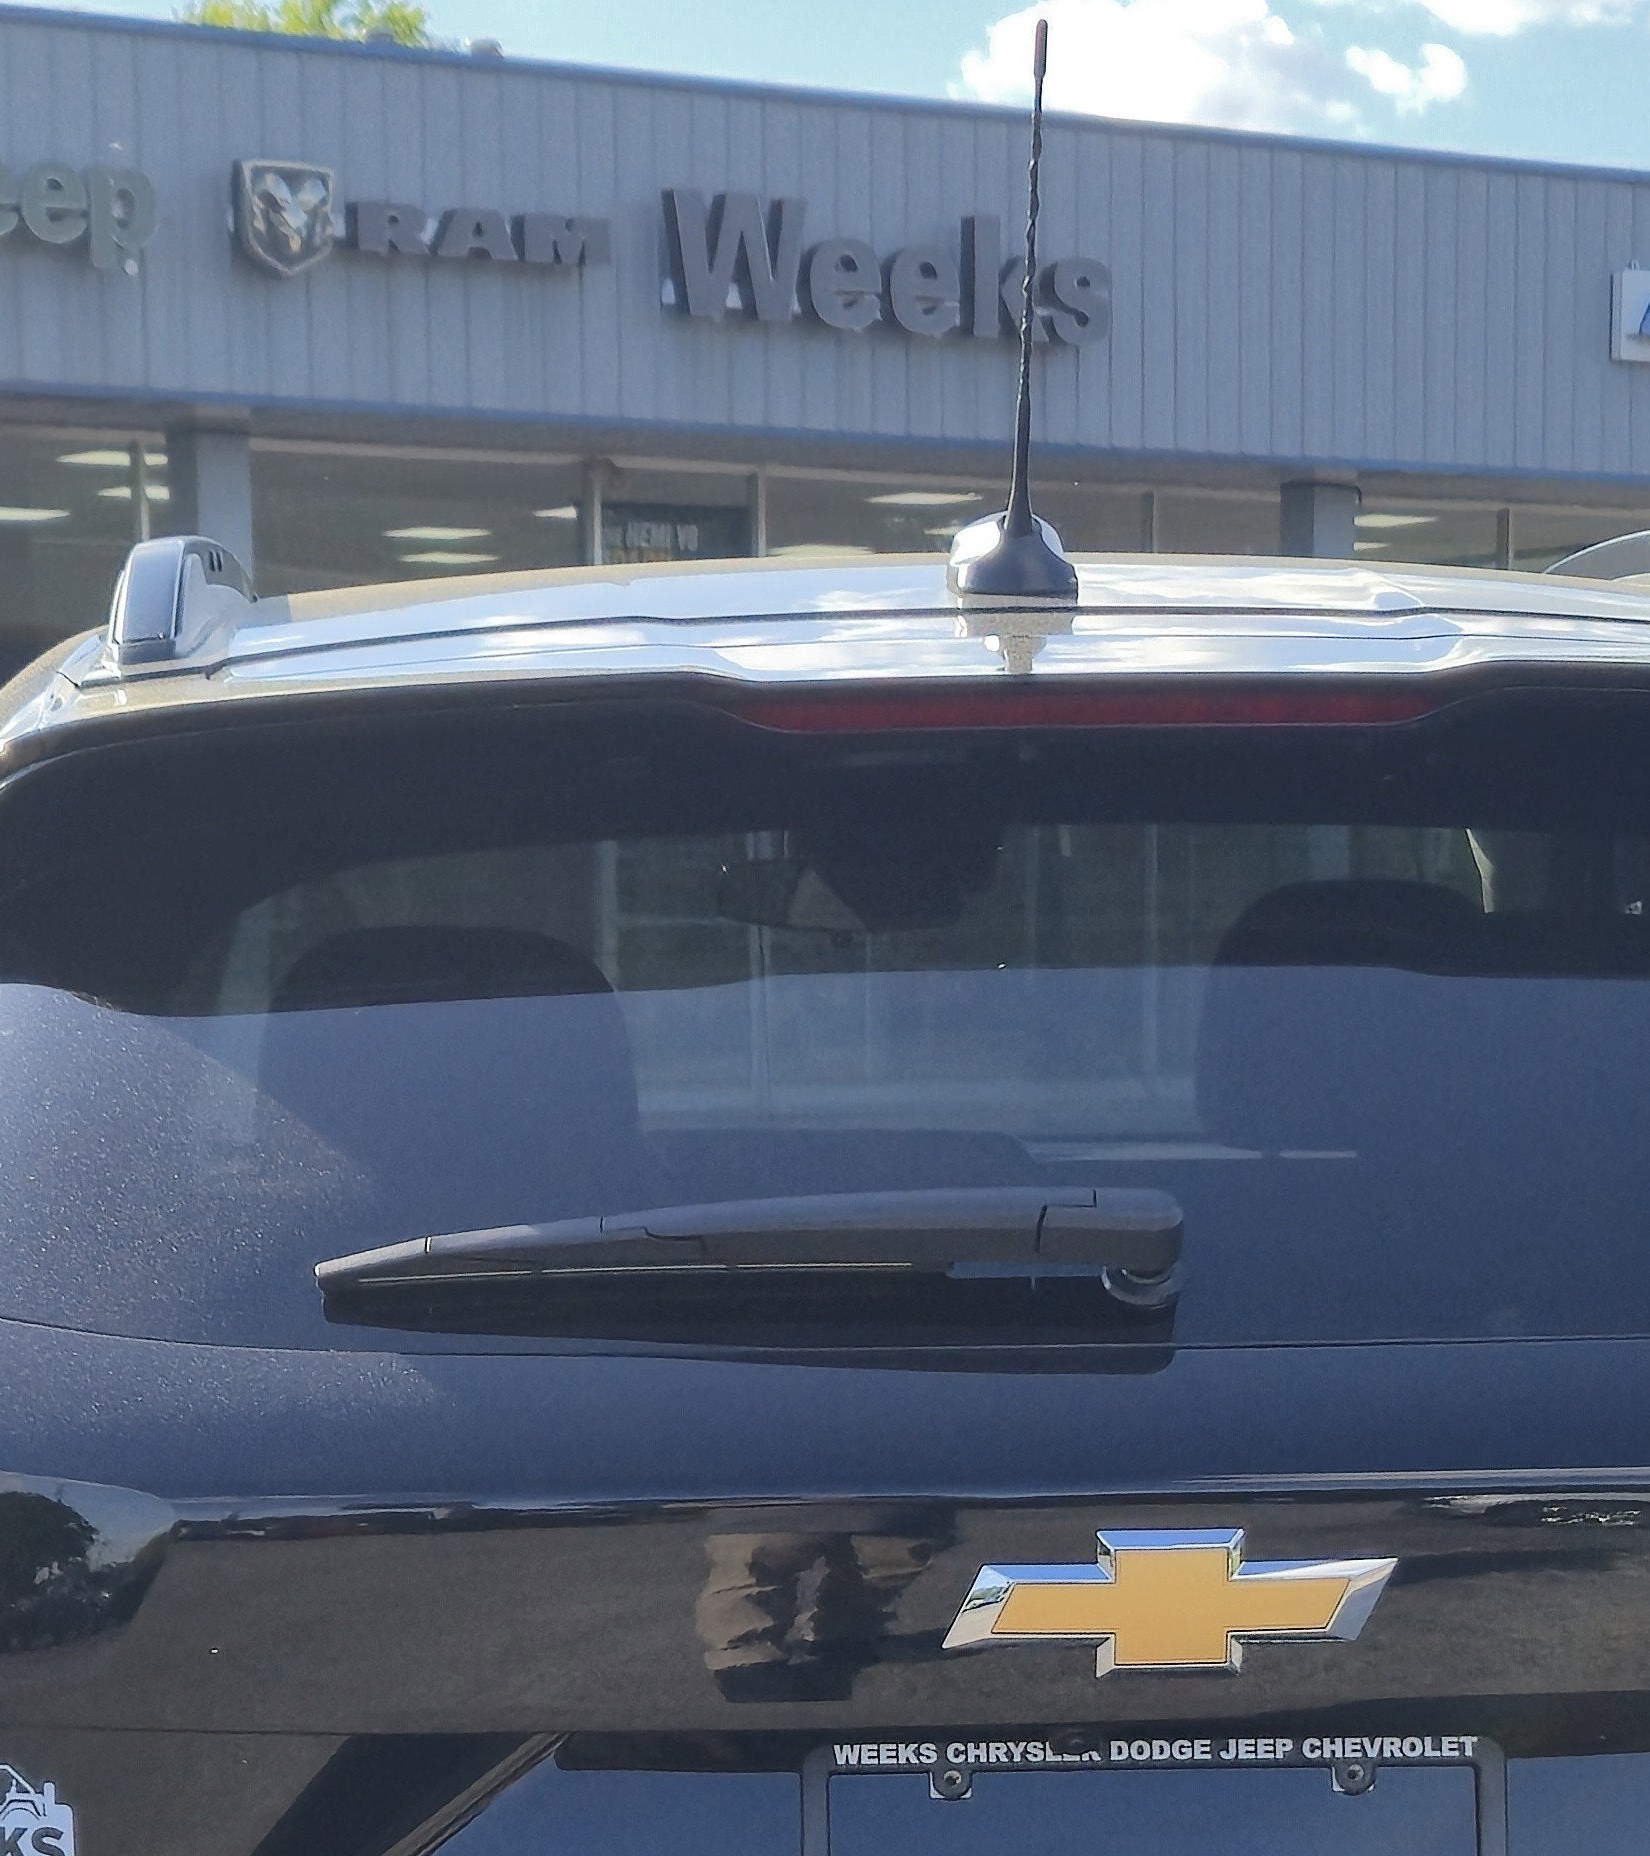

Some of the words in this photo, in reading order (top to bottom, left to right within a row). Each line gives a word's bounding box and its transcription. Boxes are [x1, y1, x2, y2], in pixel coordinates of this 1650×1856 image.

[345, 201, 613, 268] RAM
[658, 187, 1114, 346] Weeks
[833, 1742, 938, 1765] WEEKS
[1110, 1739, 1212, 1761] DODGE
[1220, 1737, 1294, 1760] JEEP
[1302, 1735, 1478, 1758] CHEVROLET
